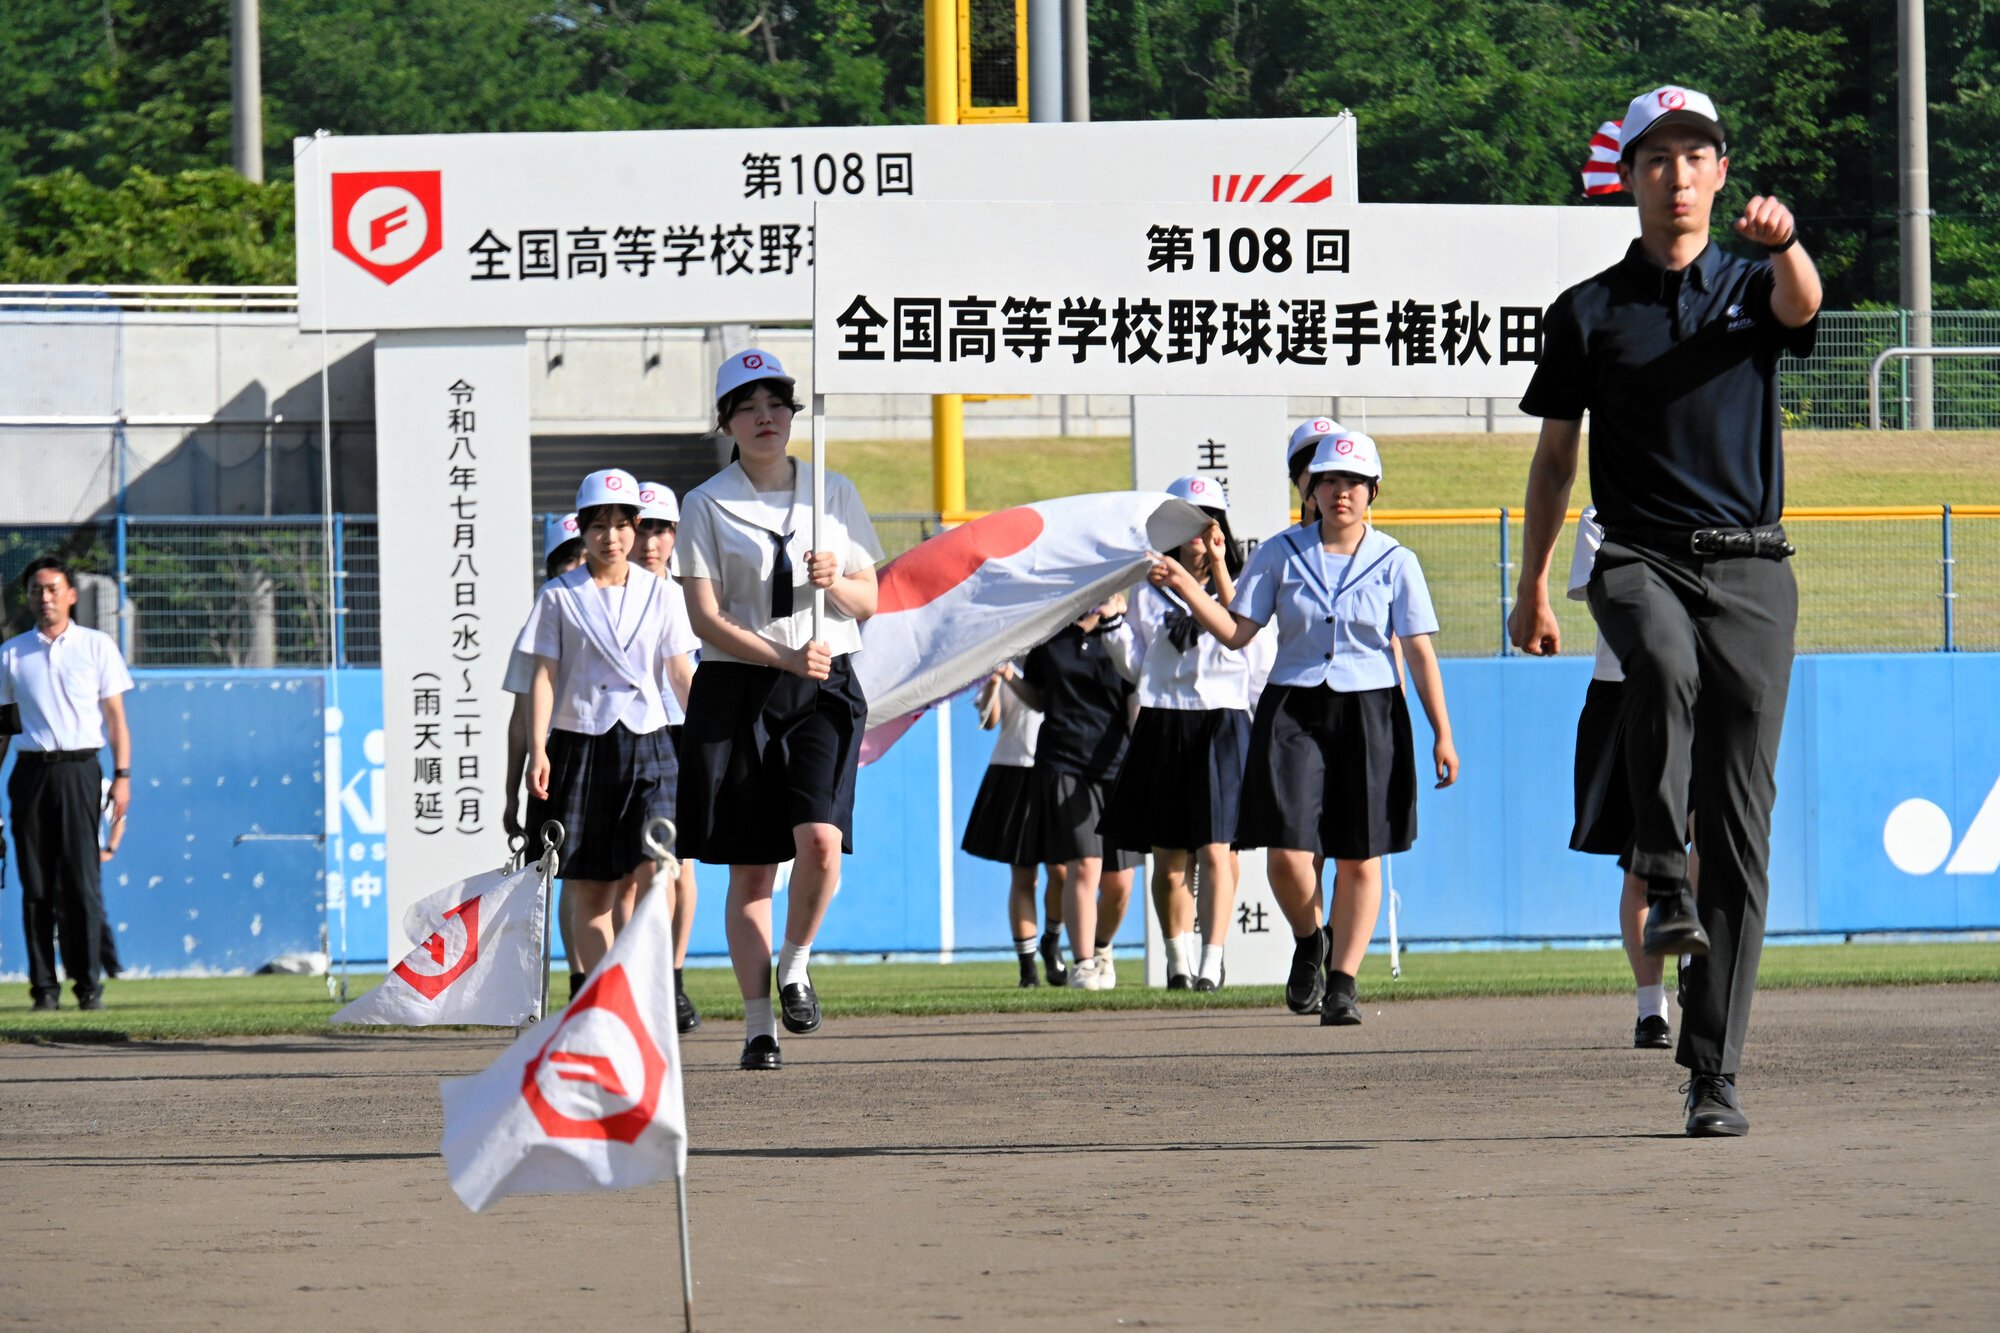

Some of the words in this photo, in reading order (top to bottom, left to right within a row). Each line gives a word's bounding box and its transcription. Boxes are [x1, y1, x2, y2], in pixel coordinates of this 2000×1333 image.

[741, 152, 913, 199] 第108回
[468, 223, 814, 281] 全国高等学校野
[1145, 224, 1350, 274] 第108回
[835, 294, 1543, 367] 全国高等学校野球選手権秋田
[1237, 901, 1270, 934] 社
